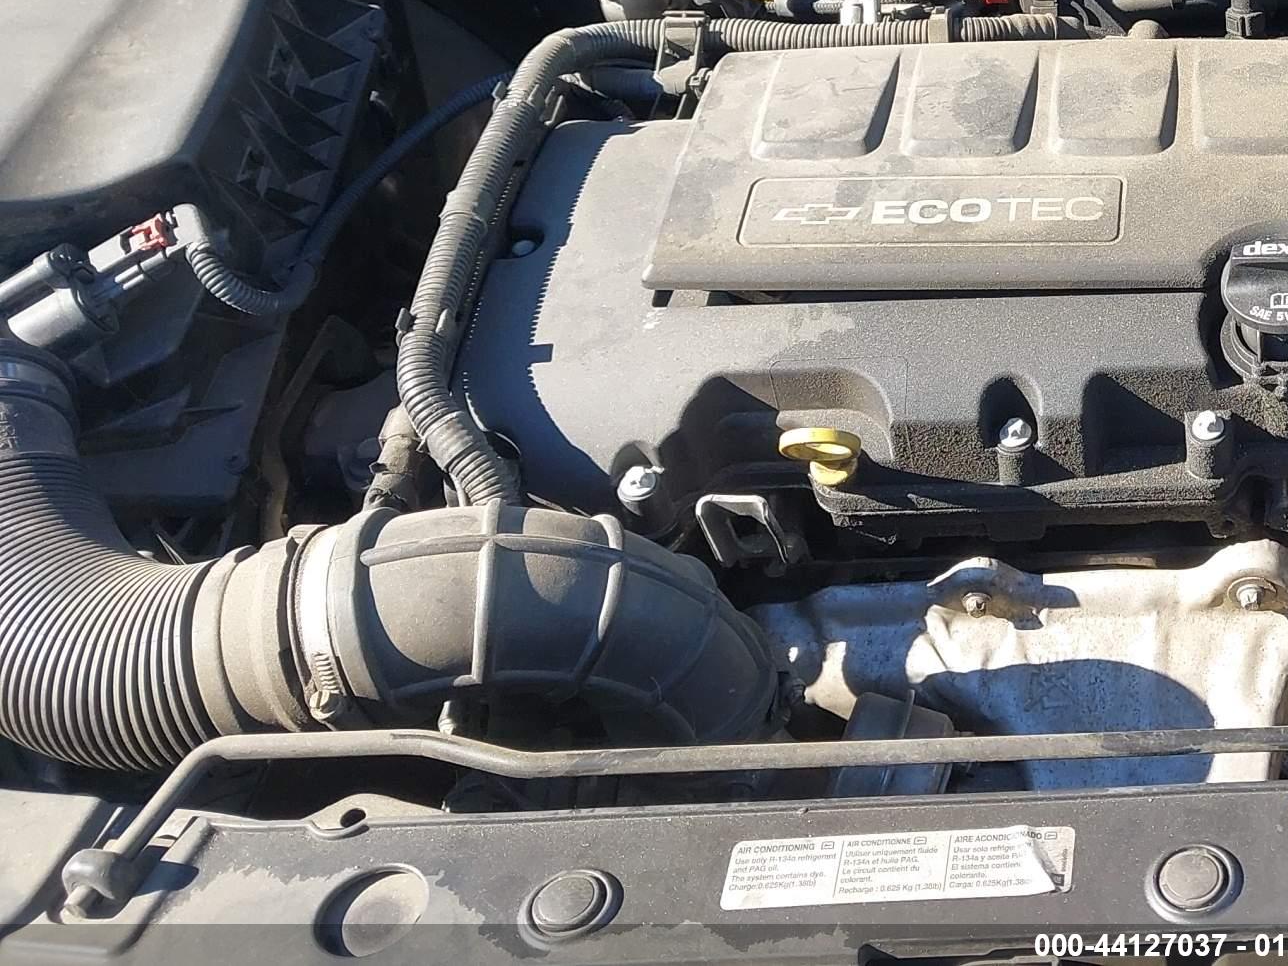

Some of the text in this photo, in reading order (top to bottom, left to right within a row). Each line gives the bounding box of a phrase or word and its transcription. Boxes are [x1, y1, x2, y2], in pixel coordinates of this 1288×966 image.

[1250, 305, 1273, 321] SAE
[738, 843, 815, 854] AIR CONDITIONING
[847, 840, 860, 848] AIR
[872, 848, 916, 856] uniquement
[918, 846, 938, 854] fluide
[954, 846, 971, 854] Usar
[752, 856, 768, 864] only
[797, 854, 836, 862] refrigerant
[732, 866, 748, 874] and
[768, 864, 780, 872] oil.
[877, 865, 908, 873] contient
[910, 864, 920, 872] du
[960, 862, 989, 870] sistema
[746, 874, 774, 882] system
[776, 872, 808, 880] contains
[810, 870, 826, 878] dye.
[840, 876, 872, 884] colorant.
[839, 886, 874, 894] Recharge
[880, 884, 900, 892] 0.625
[902, 884, 913, 892] Kg
